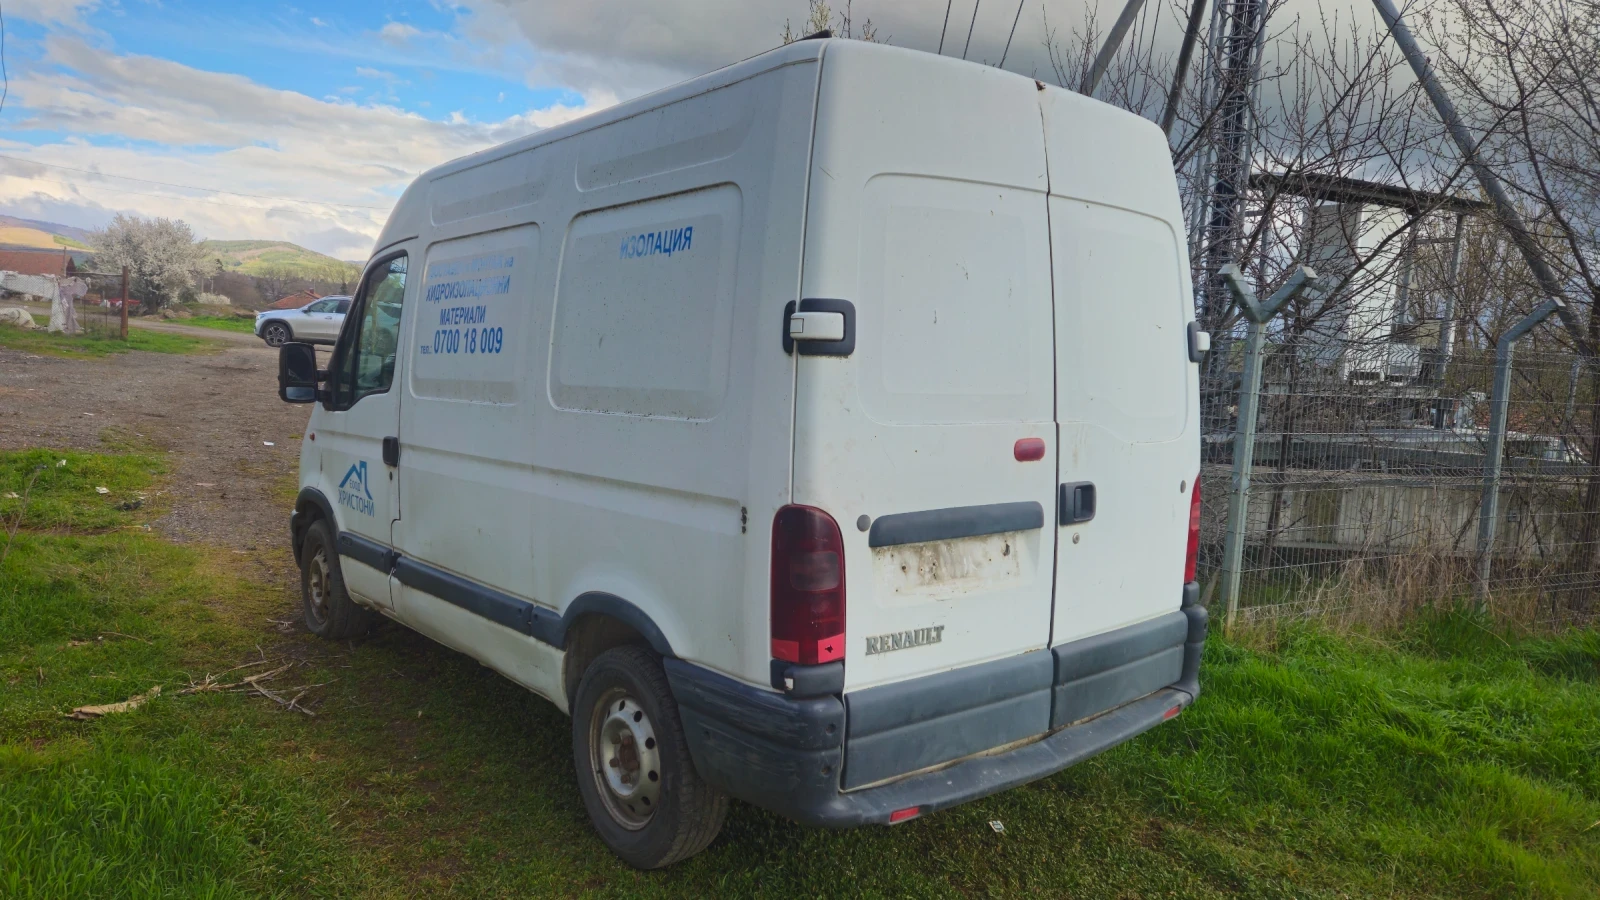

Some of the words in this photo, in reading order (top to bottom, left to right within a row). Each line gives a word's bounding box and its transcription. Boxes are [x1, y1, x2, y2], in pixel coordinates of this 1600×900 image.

[620, 226, 693, 259] ИЗОЛАЦИЯ
[440, 305, 486, 325] МАТЕРИАЛИ
[433, 329, 460, 354] 0700
[464, 328, 477, 354] 18
[480, 327, 503, 354] 009
[338, 489, 375, 518] ХРИСТОНИ
[865, 625, 945, 656] RENAULT
